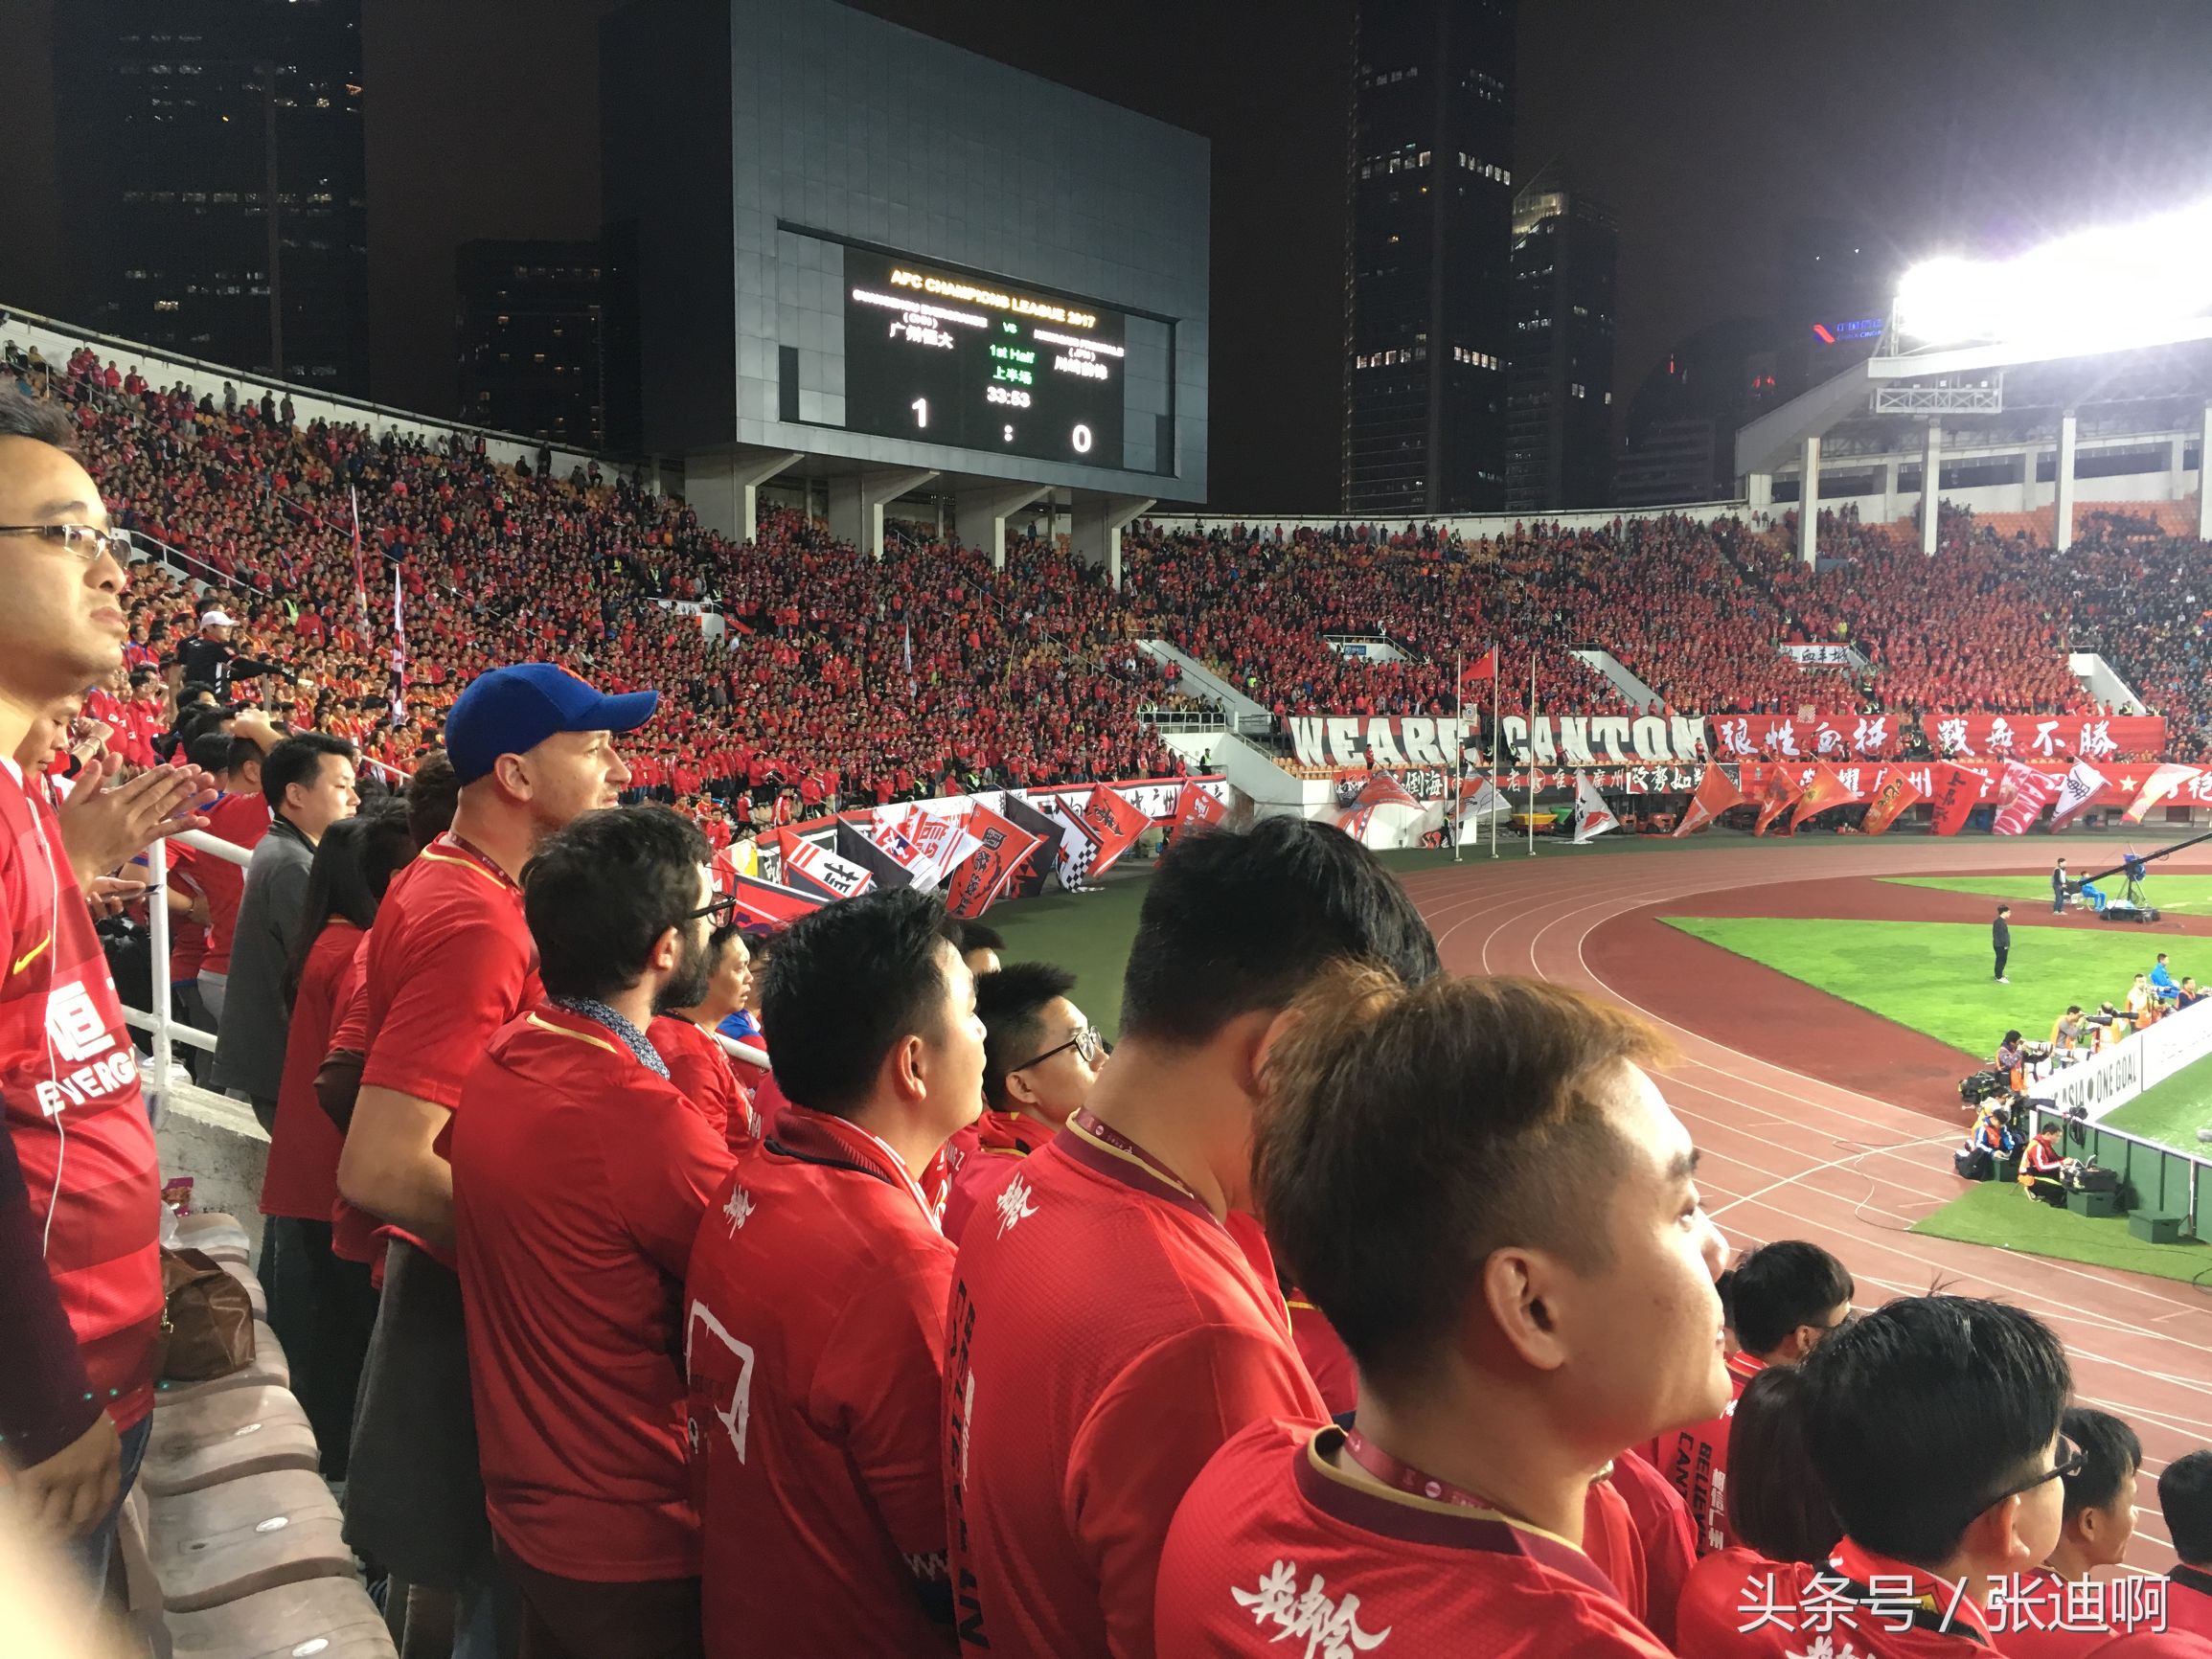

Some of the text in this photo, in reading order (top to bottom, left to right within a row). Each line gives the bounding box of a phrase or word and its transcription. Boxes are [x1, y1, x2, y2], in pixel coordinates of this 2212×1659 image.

[891, 269, 924, 288] AFC
[924, 278, 1011, 309] CHAMPIONS
[1012, 297, 1066, 322] LEAGUE
[1067, 310, 1097, 329] 2017
[990, 344, 1036, 364] 1st Half
[992, 365, 1033, 385] 上半场
[987, 385, 1032, 408] 33:53
[911, 398, 927, 428] 1
[1072, 424, 1092, 453] 0
[1502, 716, 1706, 762] CANTON
[1553, 767, 1625, 793] 唯廣州
[2096, 1063, 2113, 1103] ONE
[2115, 1052, 2136, 1092] GOAL
